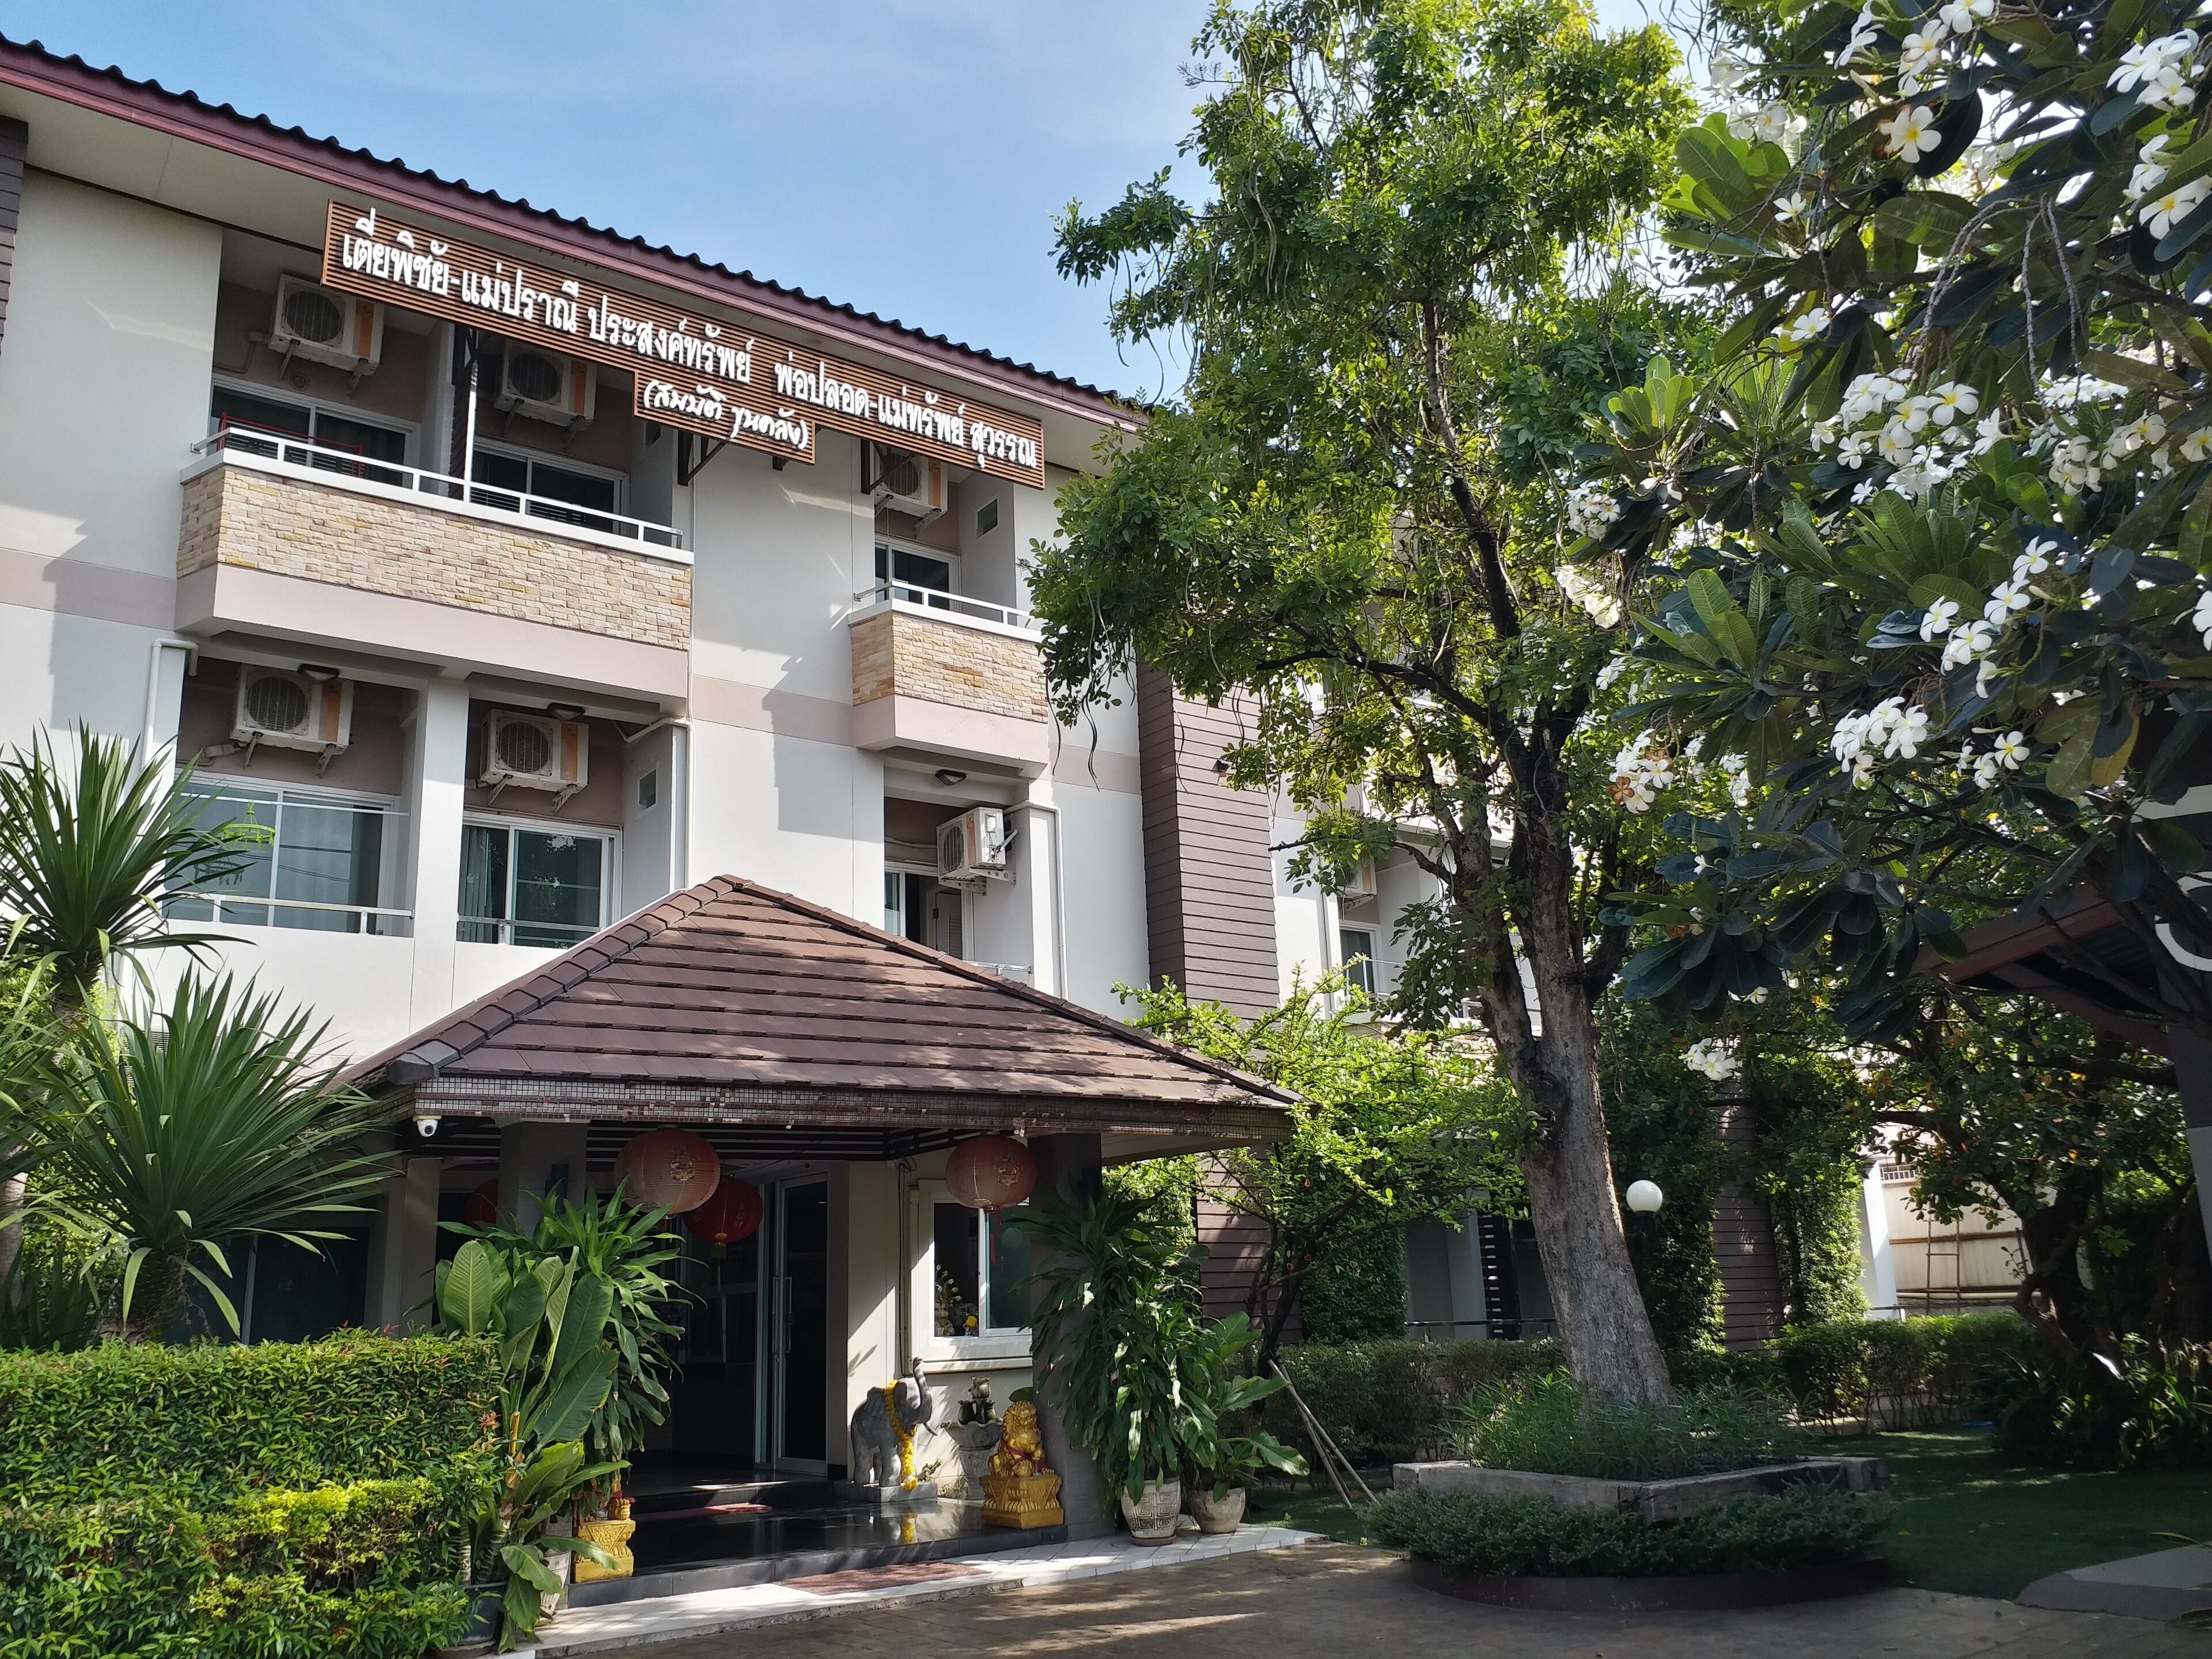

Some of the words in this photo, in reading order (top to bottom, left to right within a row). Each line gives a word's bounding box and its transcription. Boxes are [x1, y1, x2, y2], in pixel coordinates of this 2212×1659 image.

[343, 207, 579, 333] เตี่ยพิชัย-แม่ปราณี
[588, 295, 755, 384] ประสงค์ทรัพย์
[774, 351, 967, 447] พ่อปลอด-แม่ทรัพย์
[969, 421, 1037, 469] สุวรรณ
